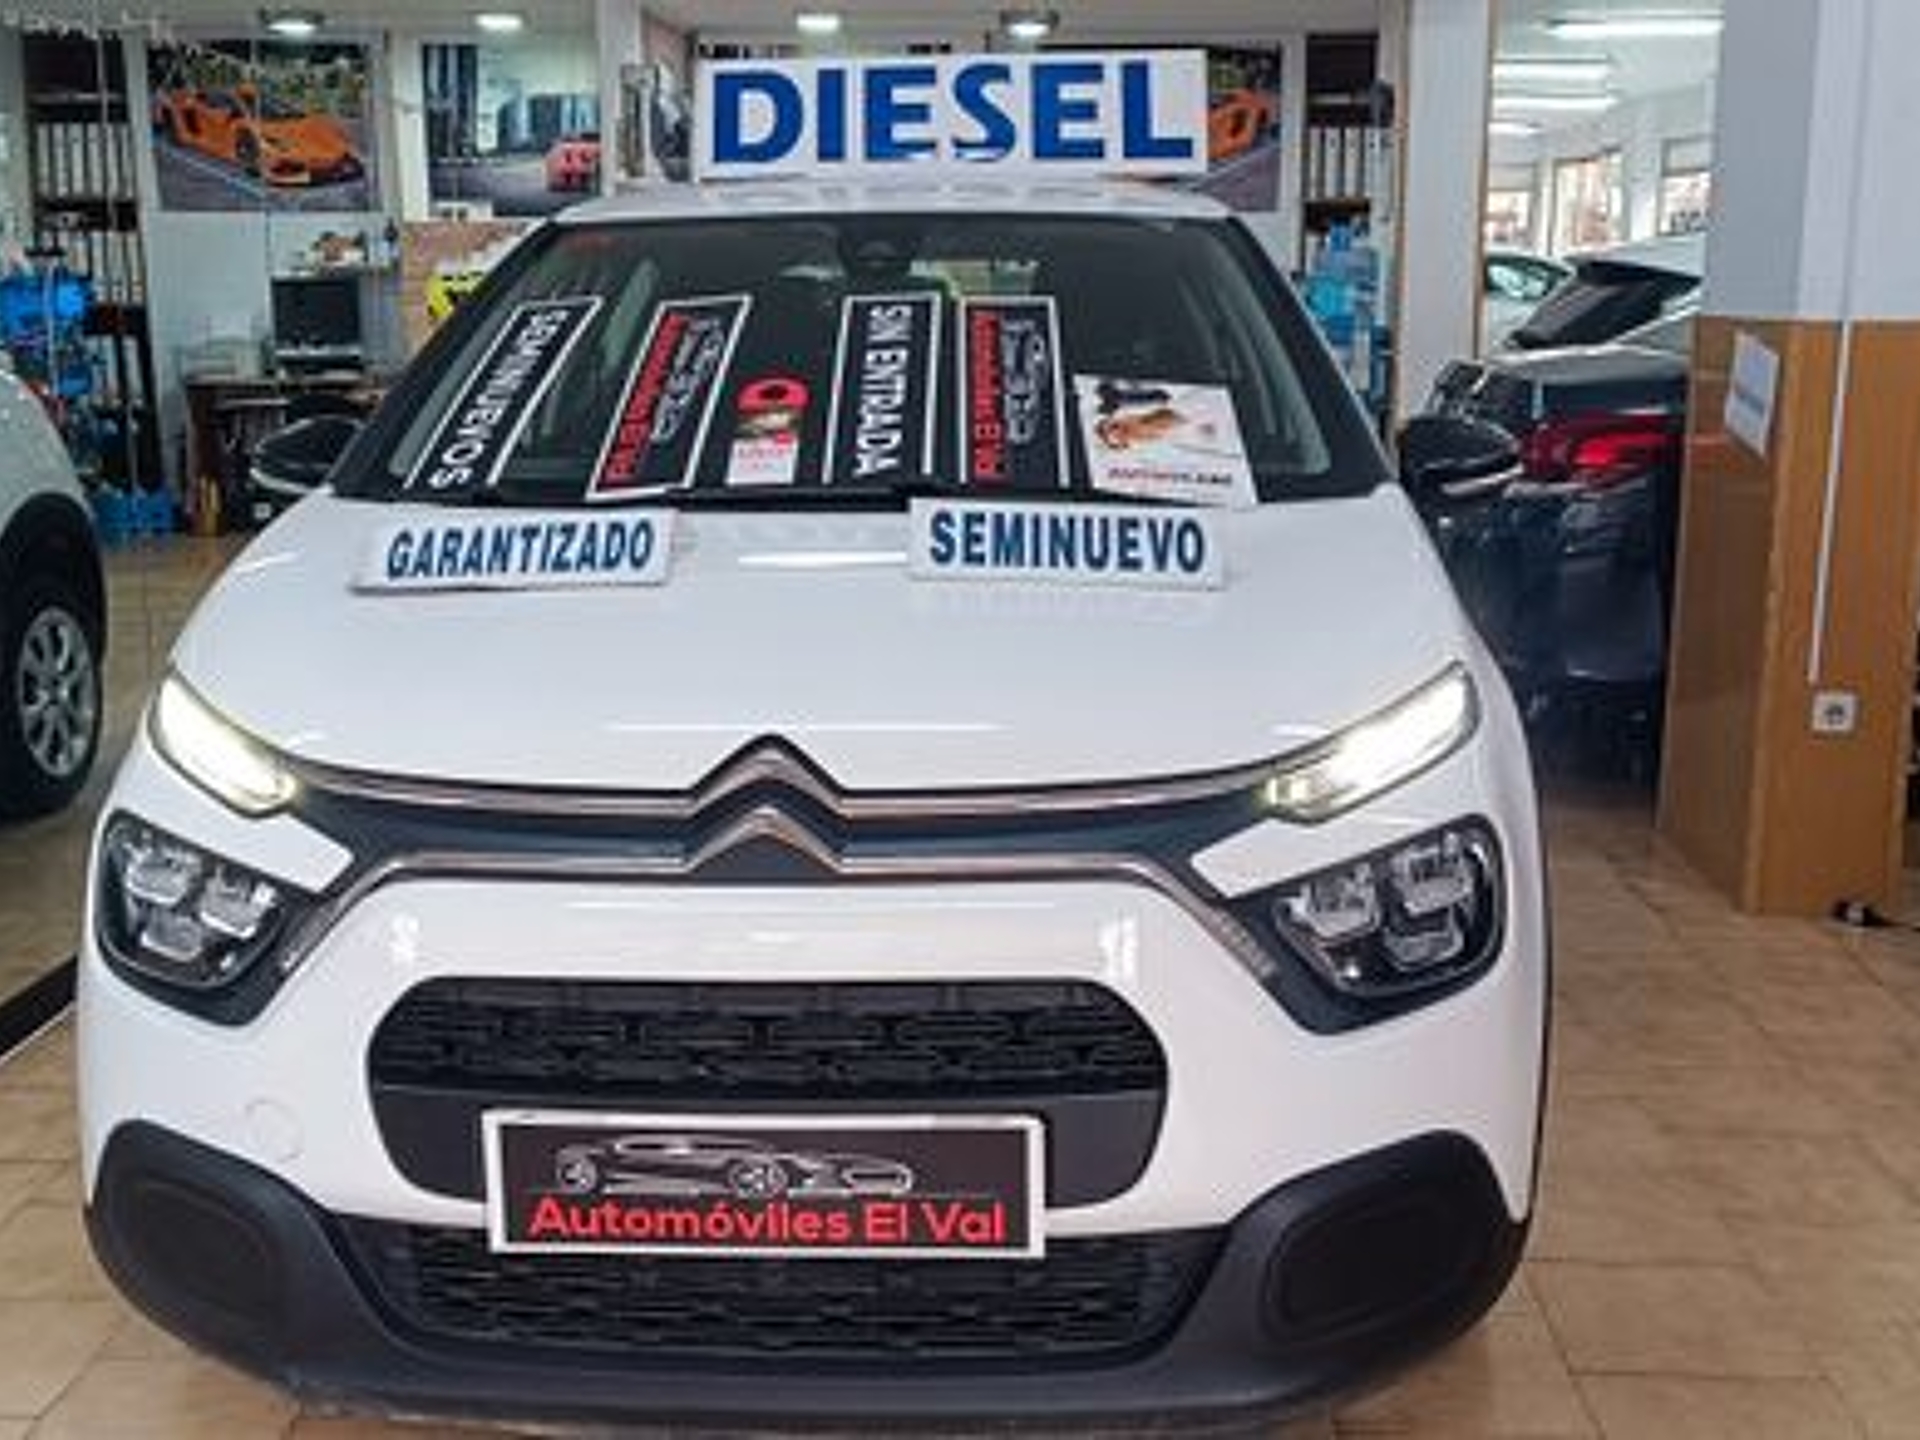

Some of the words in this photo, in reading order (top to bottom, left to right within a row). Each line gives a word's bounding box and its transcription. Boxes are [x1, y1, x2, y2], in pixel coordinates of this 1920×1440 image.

[713, 60, 1193, 163] DIESEL
[868, 305, 912, 341] SIN
[428, 310, 569, 488] SEMINUEVOS
[854, 347, 908, 476] ENTRADA
[386, 518, 655, 580] GARANTIZADO
[929, 509, 1205, 573] SEMINUEVO
[529, 1194, 851, 1241] Automóviles
[863, 1201, 909, 1240] El
[922, 1201, 1005, 1242] Val
